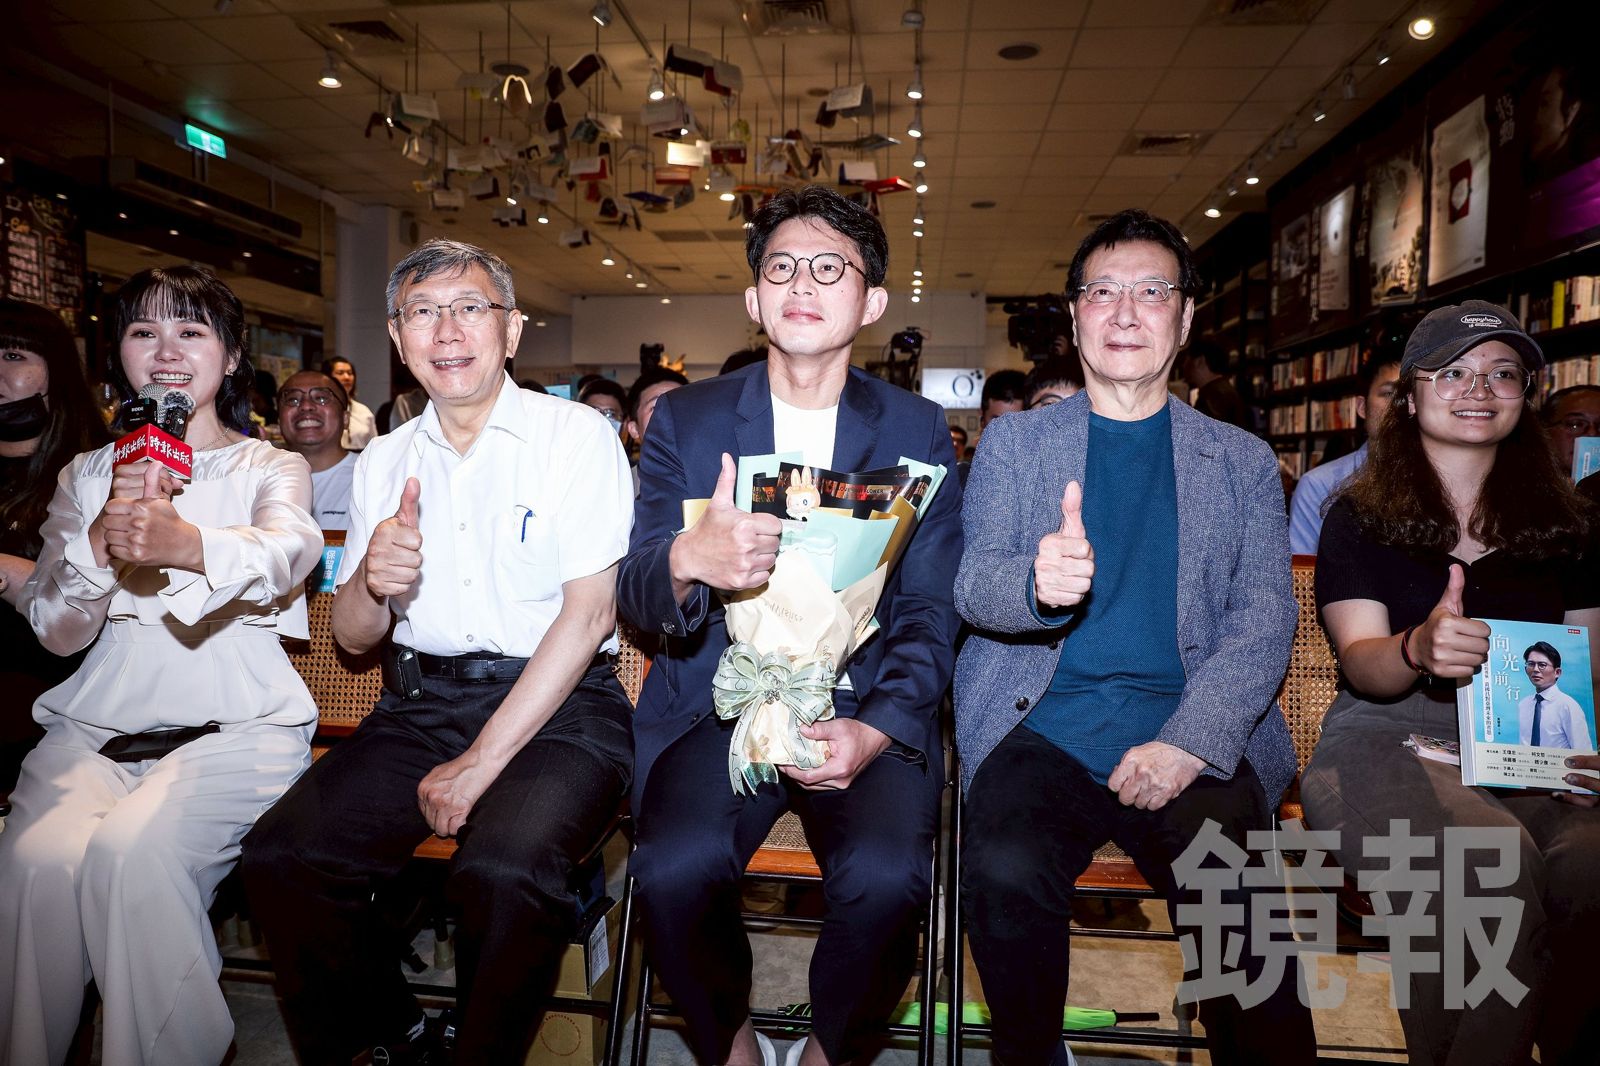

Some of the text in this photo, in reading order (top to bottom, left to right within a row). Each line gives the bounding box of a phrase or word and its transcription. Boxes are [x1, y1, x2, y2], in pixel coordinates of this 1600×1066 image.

[149, 435, 191, 467] 時報出版
[1493, 635, 1520, 701] 向光前行
